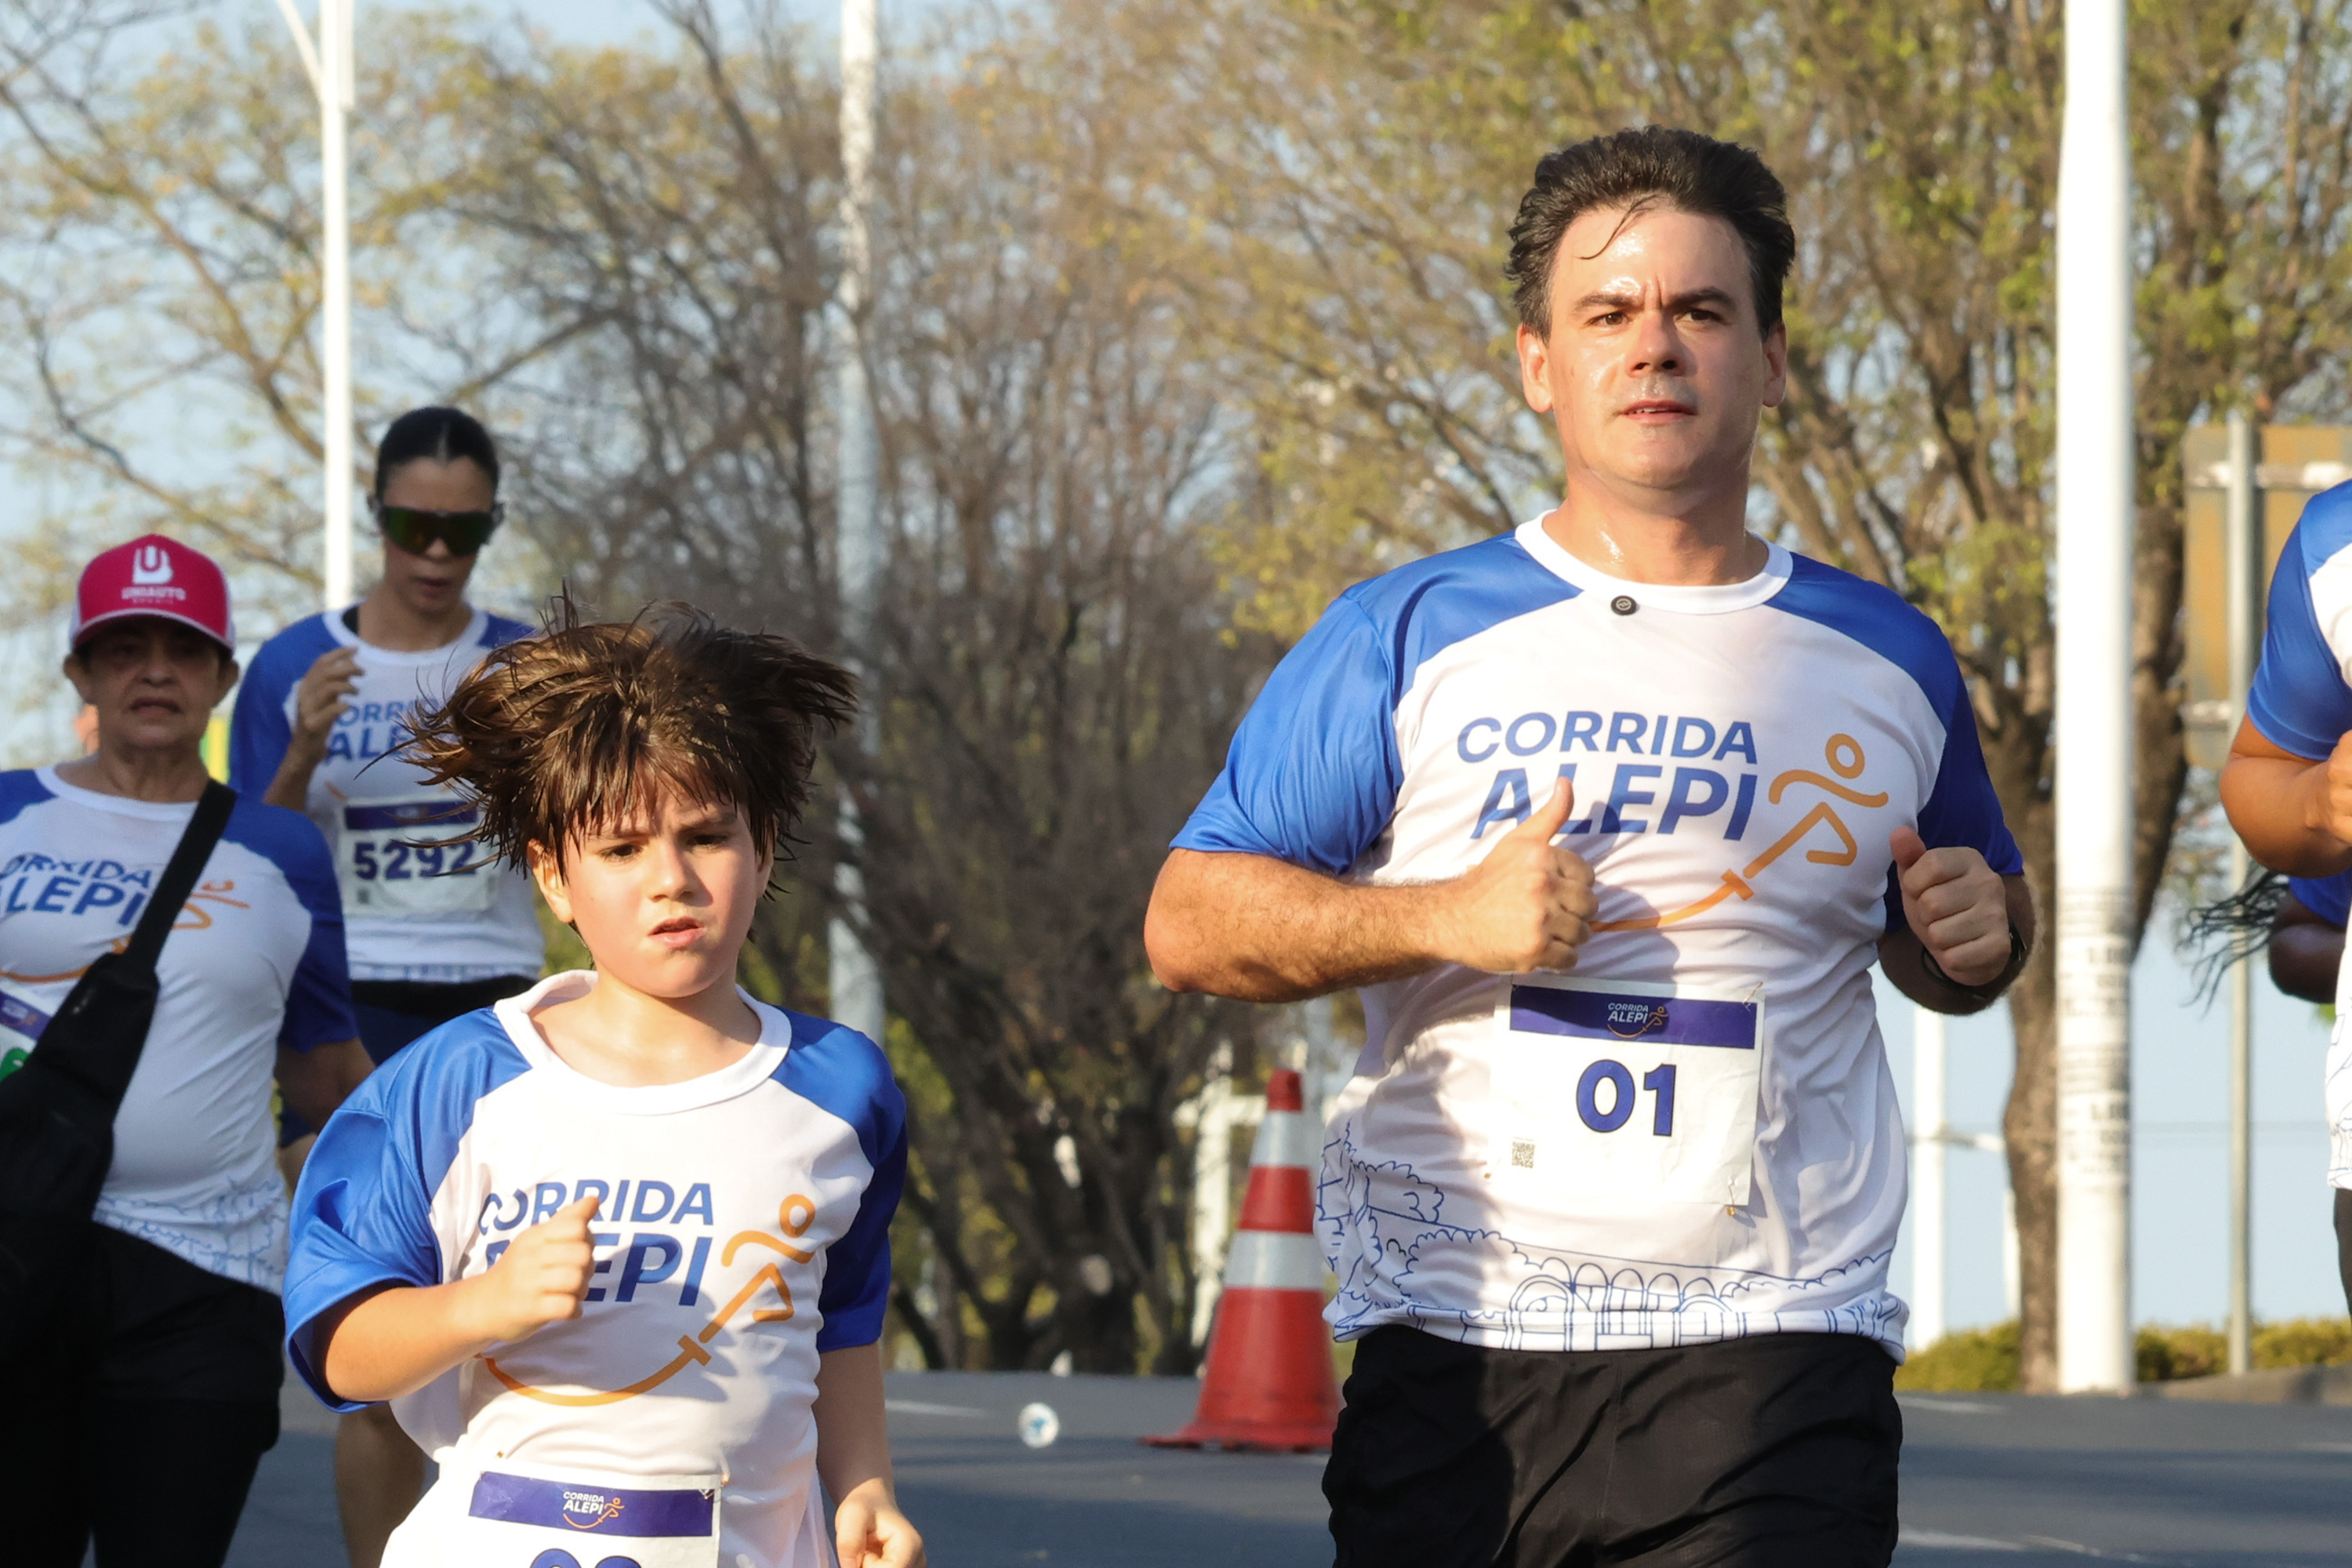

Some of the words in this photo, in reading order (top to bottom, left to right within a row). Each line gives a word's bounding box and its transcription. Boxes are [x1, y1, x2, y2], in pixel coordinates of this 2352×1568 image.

[1457, 710, 1758, 764] CORRIDA
[1470, 763, 1758, 841] ALEPI
[354, 837, 477, 880] 5292
[0, 876, 147, 927] LEPI
[1607, 1011, 1648, 1024] ALEPI
[1608, 1003, 1649, 1012] CORRIDA
[1576, 1058, 1677, 1137] 01
[563, 1491, 604, 1504] CORRIDA
[563, 1501, 603, 1515] ALEPI
